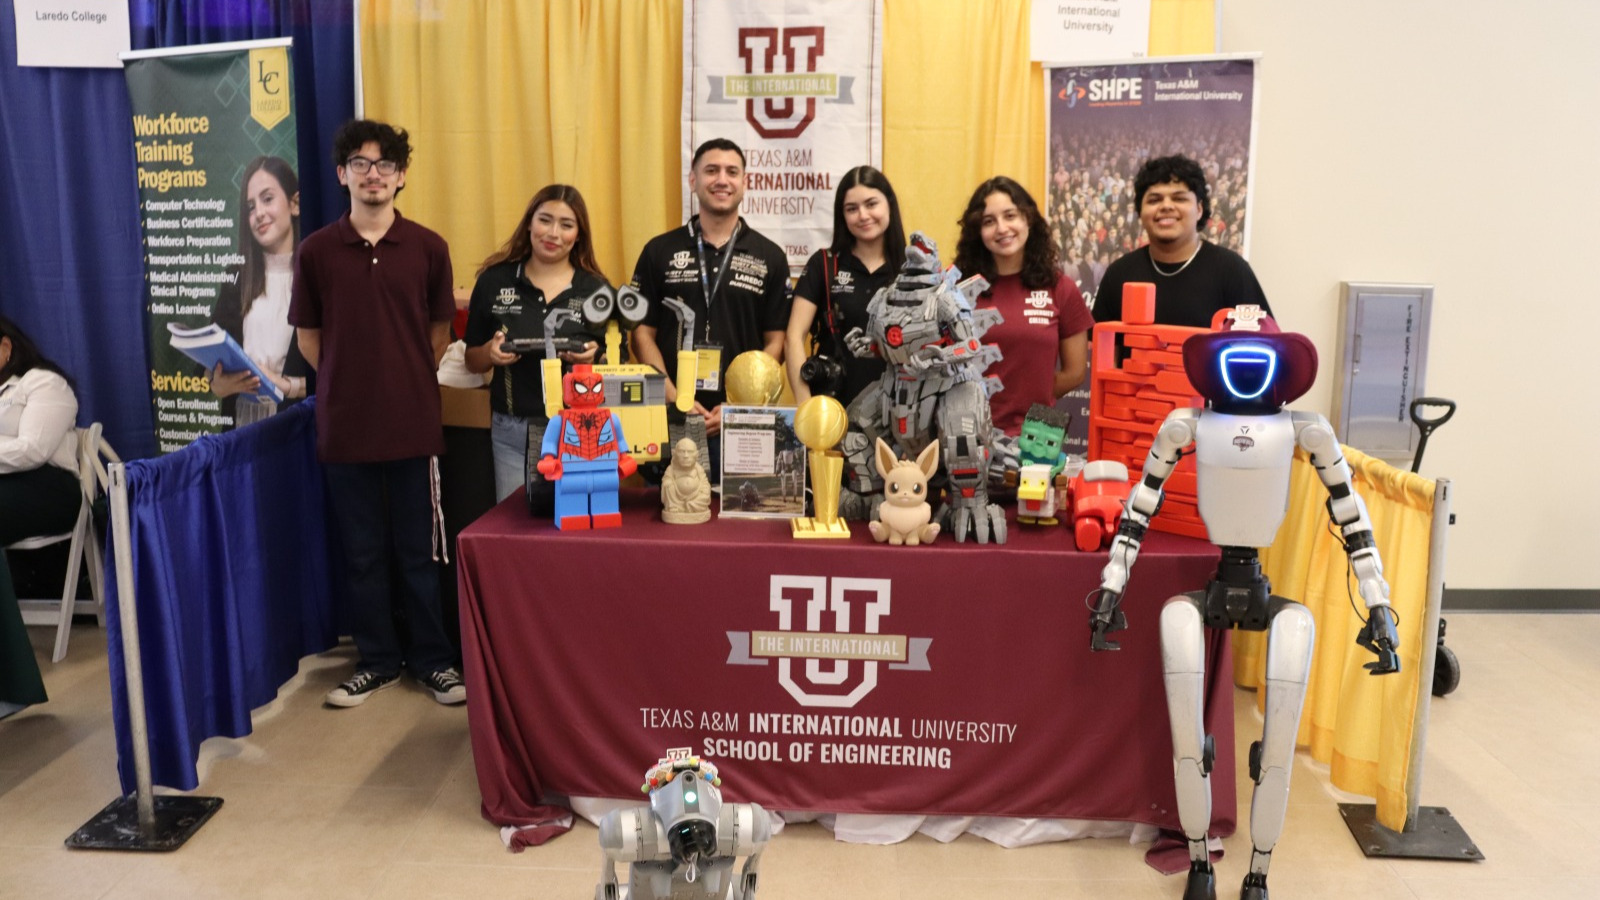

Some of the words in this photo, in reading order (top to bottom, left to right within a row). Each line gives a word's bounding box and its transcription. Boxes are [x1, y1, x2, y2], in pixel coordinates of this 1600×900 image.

[36, 11, 69, 22] Laredo
[72, 11, 108, 23] College
[1058, 5, 1120, 18] International
[1063, 20, 1113, 35] University
[730, 79, 750, 93] THE
[752, 78, 832, 93] INTERNATIONAL
[1088, 78, 1142, 101] SHPE
[1154, 80, 1177, 90] Texas
[1178, 80, 1198, 89] A&M
[1154, 92, 1202, 101] International
[1203, 91, 1243, 102] University
[133, 113, 209, 137] Workforce
[135, 141, 194, 165] Training
[743, 149, 782, 167] TEXAS
[786, 149, 812, 167] A&M
[138, 168, 206, 192] Programs
[747, 172, 832, 190] ERNATIONAL
[146, 200, 182, 213] Computer
[182, 198, 226, 212] Technology
[742, 197, 815, 215] UNIVERSITY
[146, 218, 180, 229] Business
[181, 216, 234, 228] Certifications
[147, 235, 184, 247] Workforce
[186, 235, 231, 248] Preparation
[785, 245, 808, 256] TEXAS
[148, 253, 202, 266] Transportation
[204, 253, 211, 264] &
[212, 253, 246, 266] Logistics
[150, 272, 178, 282] Medical
[180, 272, 239, 285] Administrative/
[735, 272, 764, 287] LAREDO
[150, 285, 178, 296] Clinical
[178, 286, 216, 299] Programs
[152, 303, 174, 314] Online
[176, 303, 211, 317] Learning
[151, 369, 210, 393] Services
[158, 397, 176, 410] Open
[177, 398, 219, 411] Enrollment
[158, 411, 188, 422] Courses
[188, 412, 196, 424] &
[198, 412, 234, 428] Programs
[160, 428, 201, 440] Customized
[758, 636, 784, 652] THE
[790, 638, 900, 656] INTERNATIONAL
[640, 708, 694, 730] TEXAS
[700, 711, 739, 732] A&M
[749, 712, 903, 739] INTERNATIONAL
[912, 718, 1018, 744] UNIVERSITY
[704, 737, 783, 762] SCHOOL
[788, 742, 814, 763] OF
[820, 743, 952, 770] ENGINEERING
